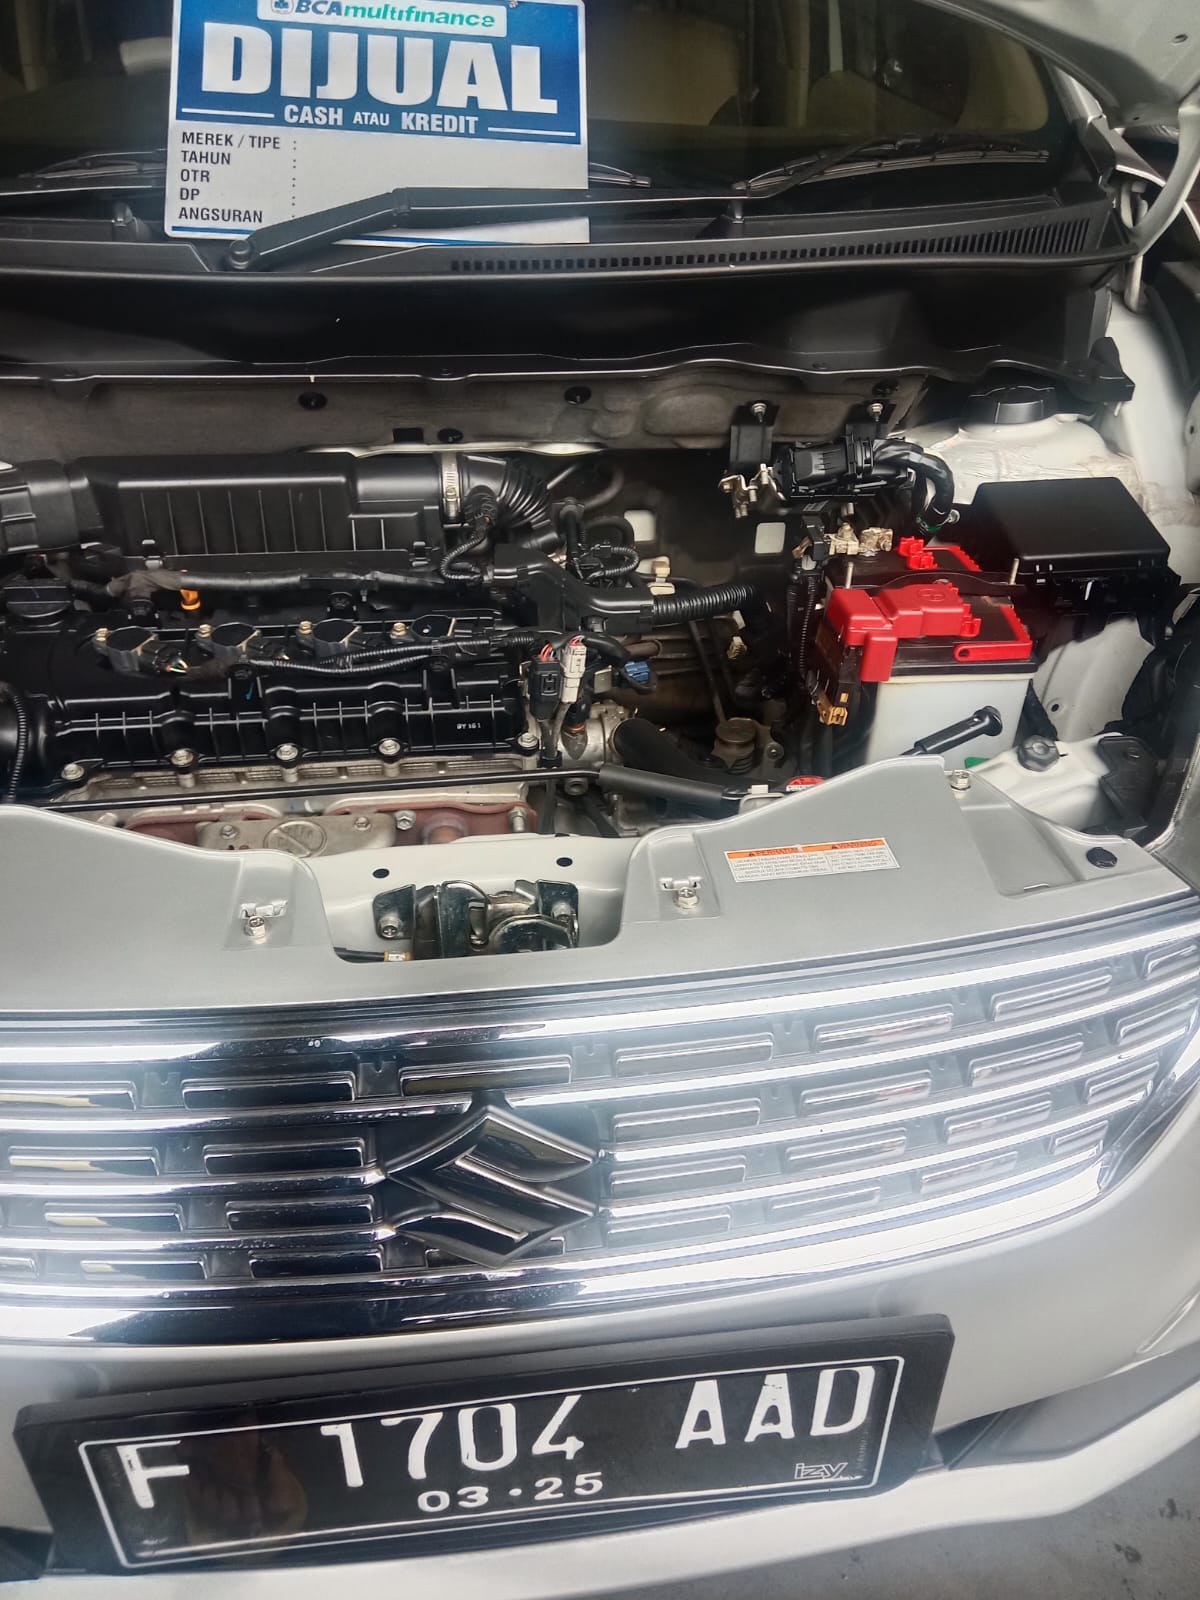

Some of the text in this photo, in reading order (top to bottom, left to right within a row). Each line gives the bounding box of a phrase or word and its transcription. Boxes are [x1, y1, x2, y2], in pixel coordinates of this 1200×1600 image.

[202, 22, 558, 114] DIJUAL
[284, 104, 479, 134] CASH ATAU KREDIT
[182, 131, 233, 147] MEREK
[249, 135, 281, 150] TIPE
[181, 150, 231, 165] TAHUN
[180, 168, 210, 183] OTR
[179, 187, 200, 201] DP
[178, 206, 263, 223] ANGSURAN
[117, 1439, 190, 1509] F
[320, 1394, 585, 1488] 1704
[675, 1365, 876, 1450] AAD
